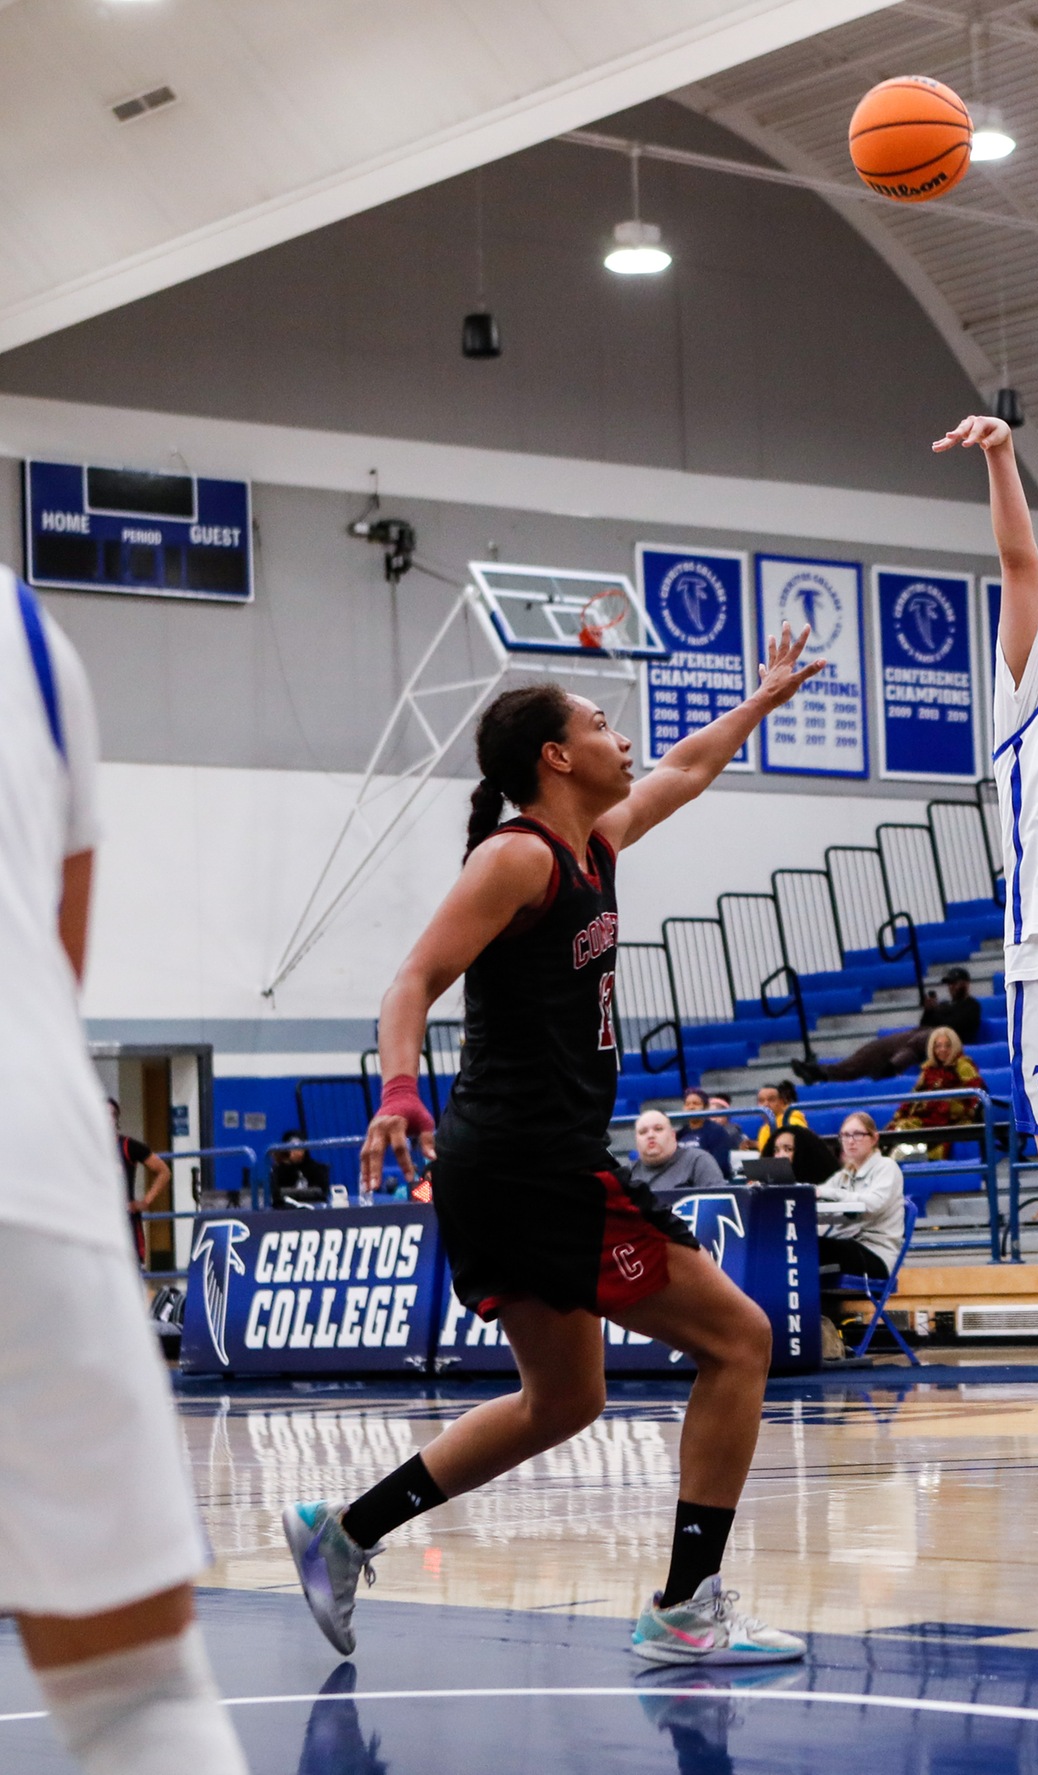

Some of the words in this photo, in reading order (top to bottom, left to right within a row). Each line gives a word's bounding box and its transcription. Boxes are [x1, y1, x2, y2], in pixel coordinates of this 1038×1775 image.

[42, 511, 91, 533] HOME
[122, 527, 162, 545] PERIOD
[190, 526, 241, 547] GUEST
[651, 668, 743, 690] CHAMPIONS
[885, 667, 969, 688] CONFERENCE
[655, 691, 678, 705] 1982
[686, 692, 710, 706] 1983
[885, 684, 970, 706] CHAMPIONS
[254, 1224, 424, 1284] CERRITOS
[612, 1243, 645, 1281] C
[784, 1199, 801, 1356] FALCONS
[244, 1284, 418, 1349] COLLEGE
